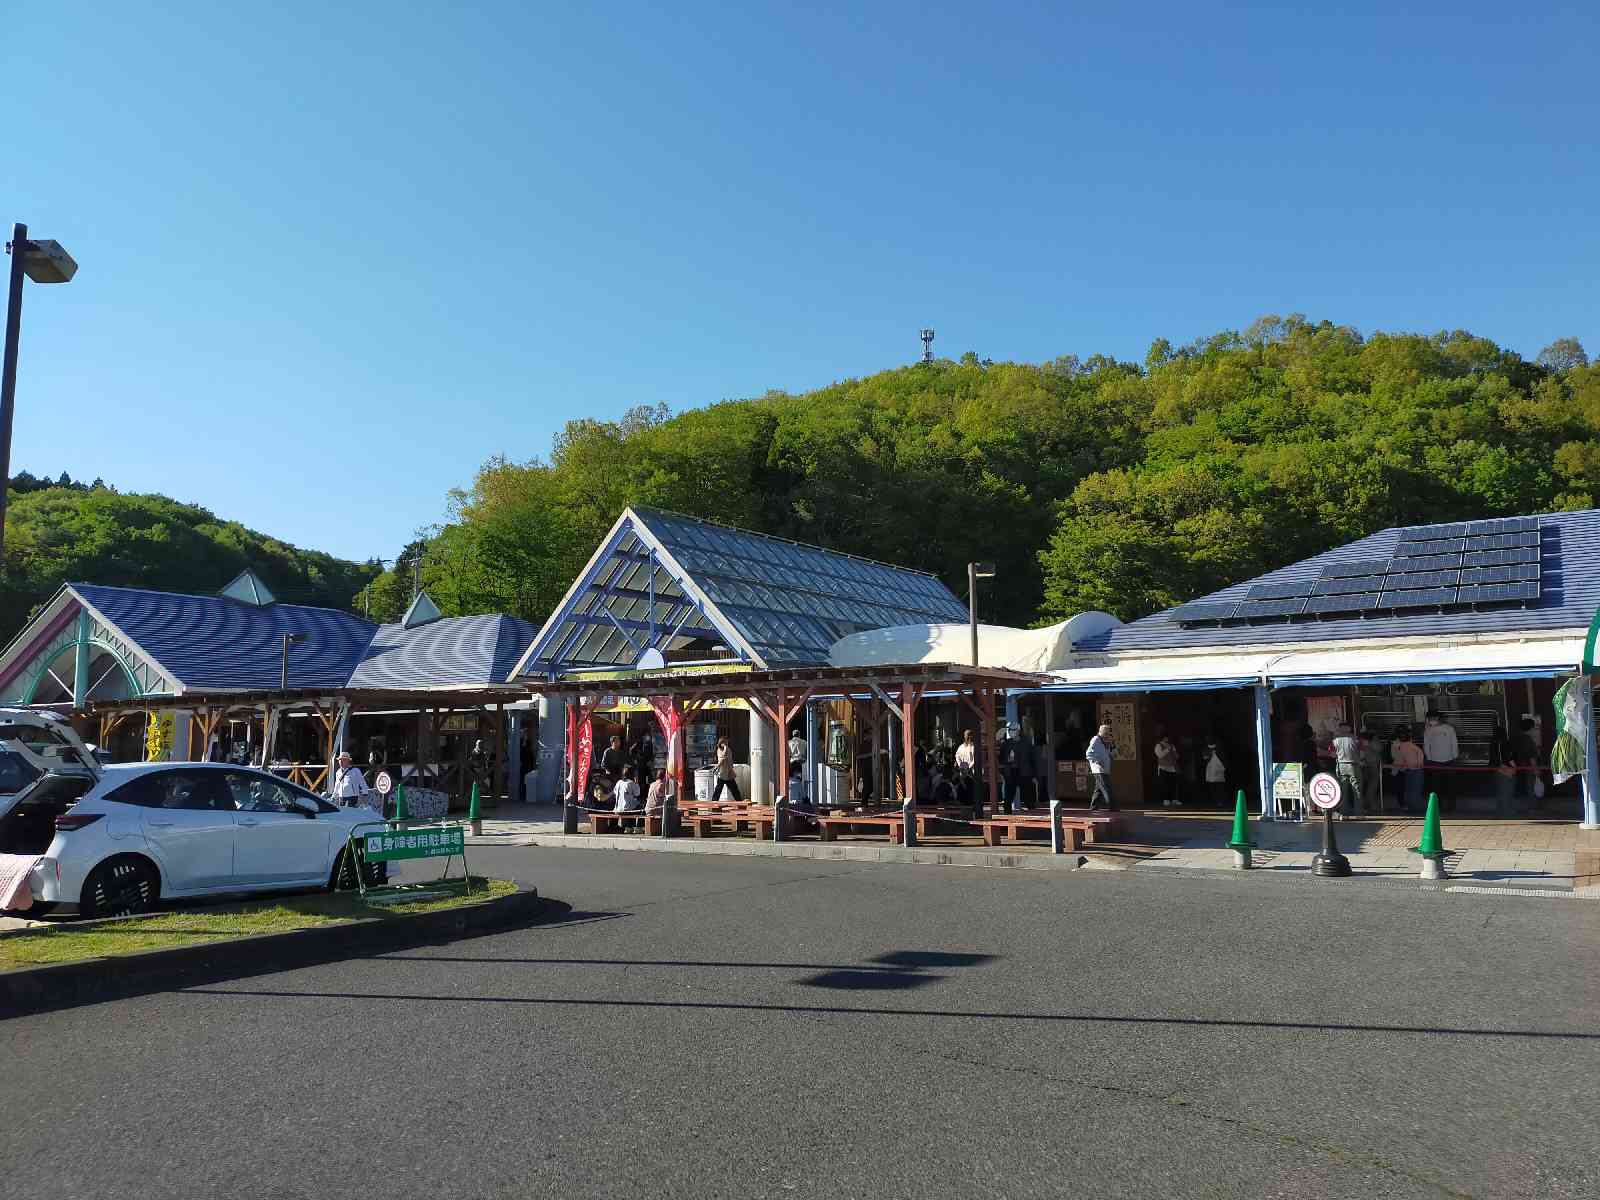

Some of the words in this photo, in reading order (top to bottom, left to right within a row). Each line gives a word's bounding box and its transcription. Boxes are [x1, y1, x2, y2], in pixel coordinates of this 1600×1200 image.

[384, 832, 461, 849] 身障者用駐車場
